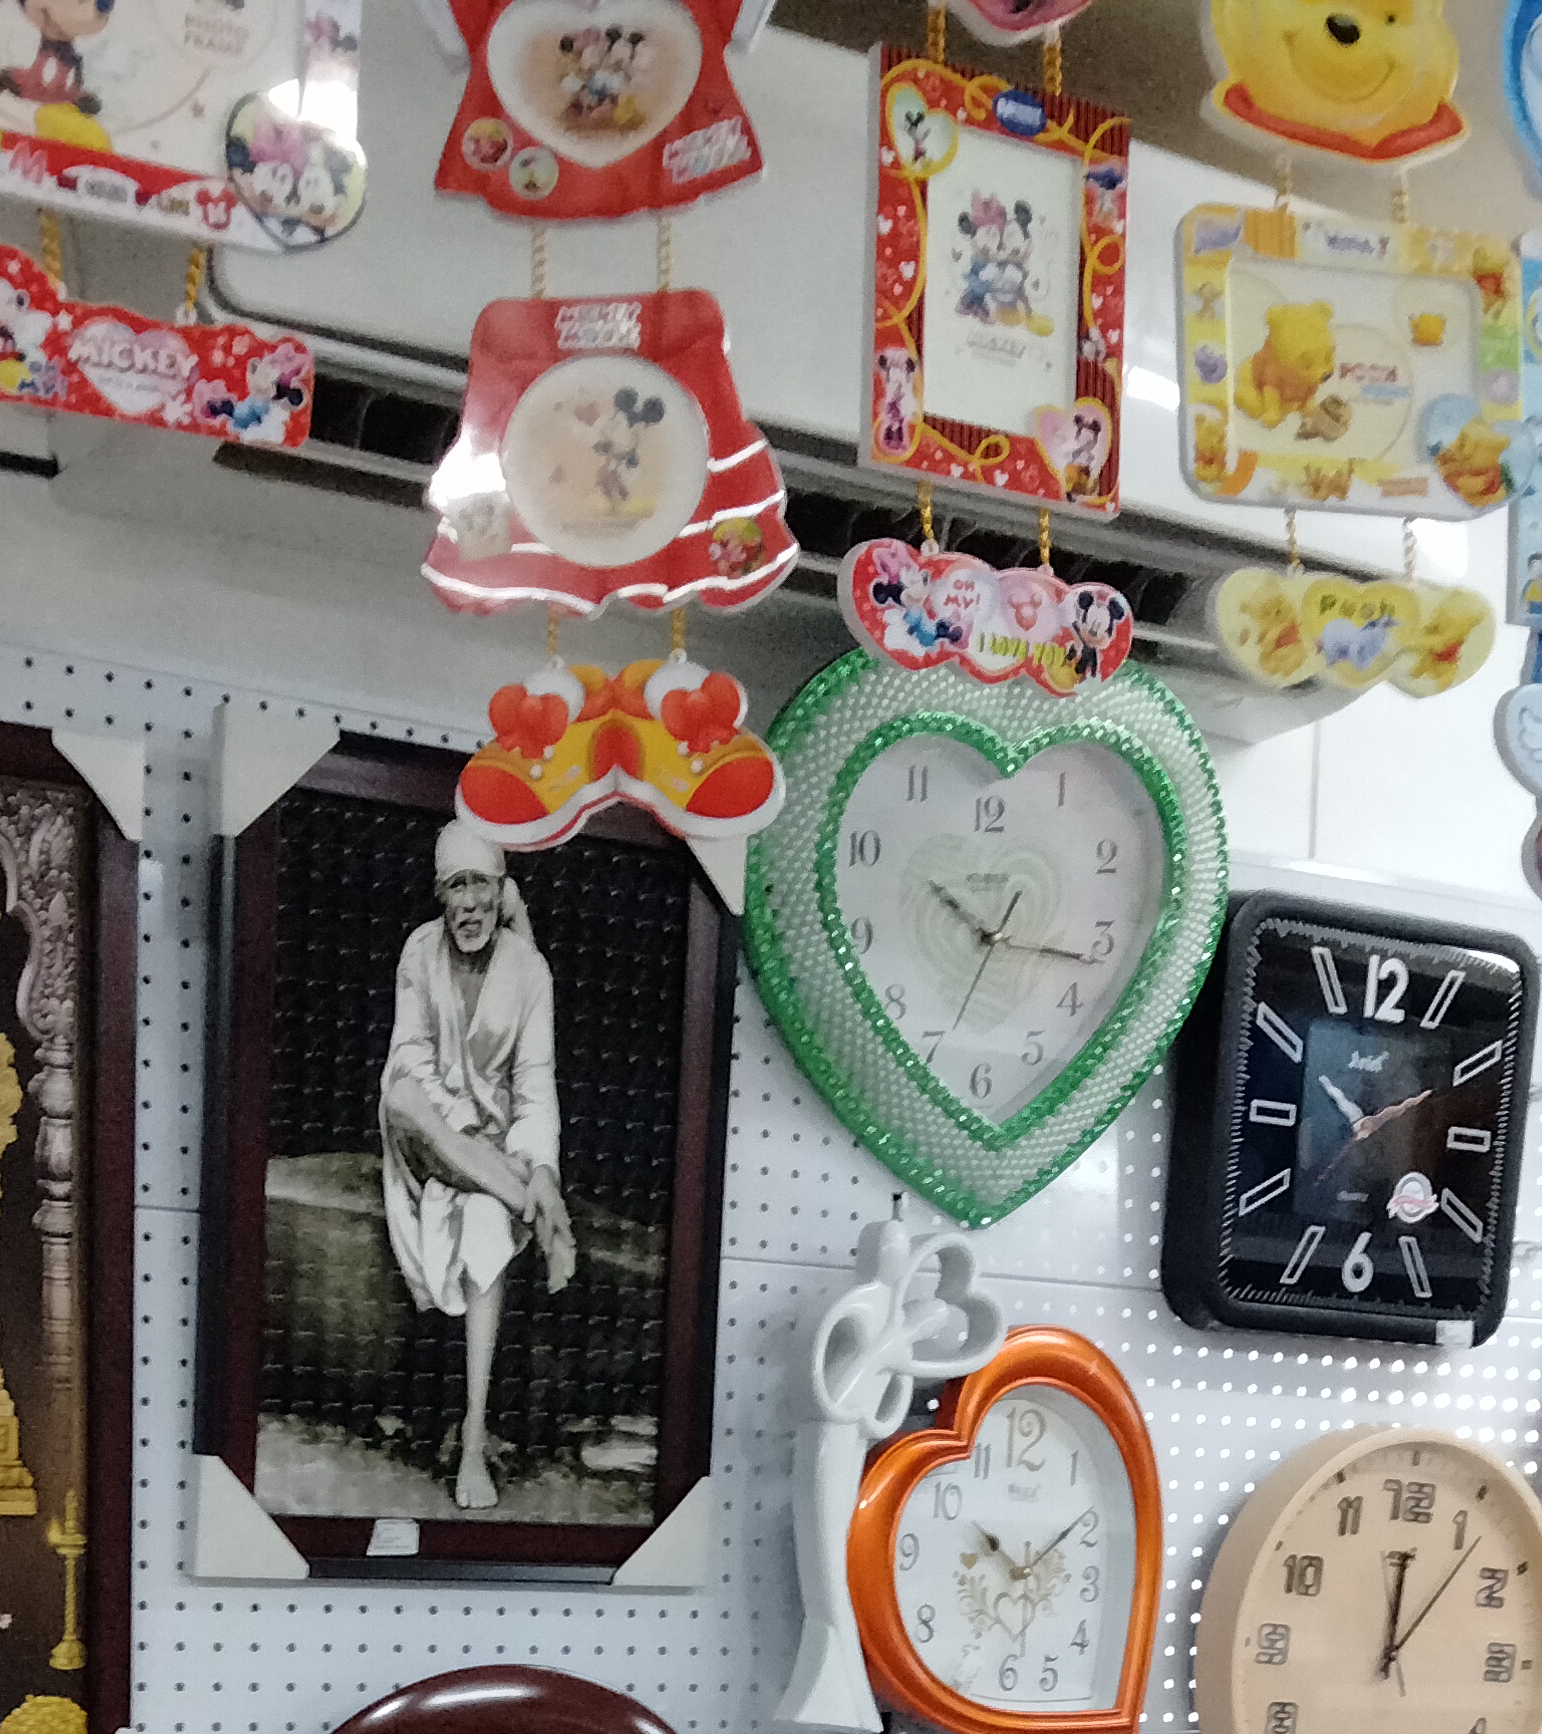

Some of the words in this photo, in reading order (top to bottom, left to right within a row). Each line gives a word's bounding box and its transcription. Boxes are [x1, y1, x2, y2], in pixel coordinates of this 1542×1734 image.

[68, 342, 199, 377] MICKEY
[906, 765, 929, 803] 11
[1057, 772, 1066, 808] 1
[974, 796, 1006, 833] 12
[848, 830, 882, 867] 10
[1095, 838, 1119, 874] 2
[851, 917, 873, 954] 9
[1093, 920, 1115, 957] 3
[885, 984, 906, 1020] 8
[1057, 981, 1084, 1017] 4
[1363, 954, 1409, 1024] 12
[922, 1030, 945, 1064] 7
[1021, 1030, 1045, 1065] 5
[970, 1062, 992, 1099] 6
[1342, 1232, 1373, 1292] 6
[1006, 1407, 1047, 1472] 12
[975, 1442, 992, 1480] 11
[1070, 1450, 1079, 1486] 1
[933, 1483, 962, 1520] 10
[1338, 1496, 1363, 1536] 11
[1382, 1479, 1435, 1523] 12
[1079, 1510, 1099, 1547] 2
[1452, 1510, 1468, 1550] 1
[899, 1533, 920, 1570] 9
[1080, 1566, 1100, 1602] 3
[1283, 1554, 1323, 1596] 10
[1476, 1567, 1509, 1609] 2
[916, 1604, 935, 1642] 8
[1070, 1619, 1089, 1655] 4
[1255, 1623, 1290, 1665] 9
[1484, 1642, 1516, 1683] 3
[999, 1654, 1018, 1691] 6
[1039, 1655, 1059, 1692] 5
